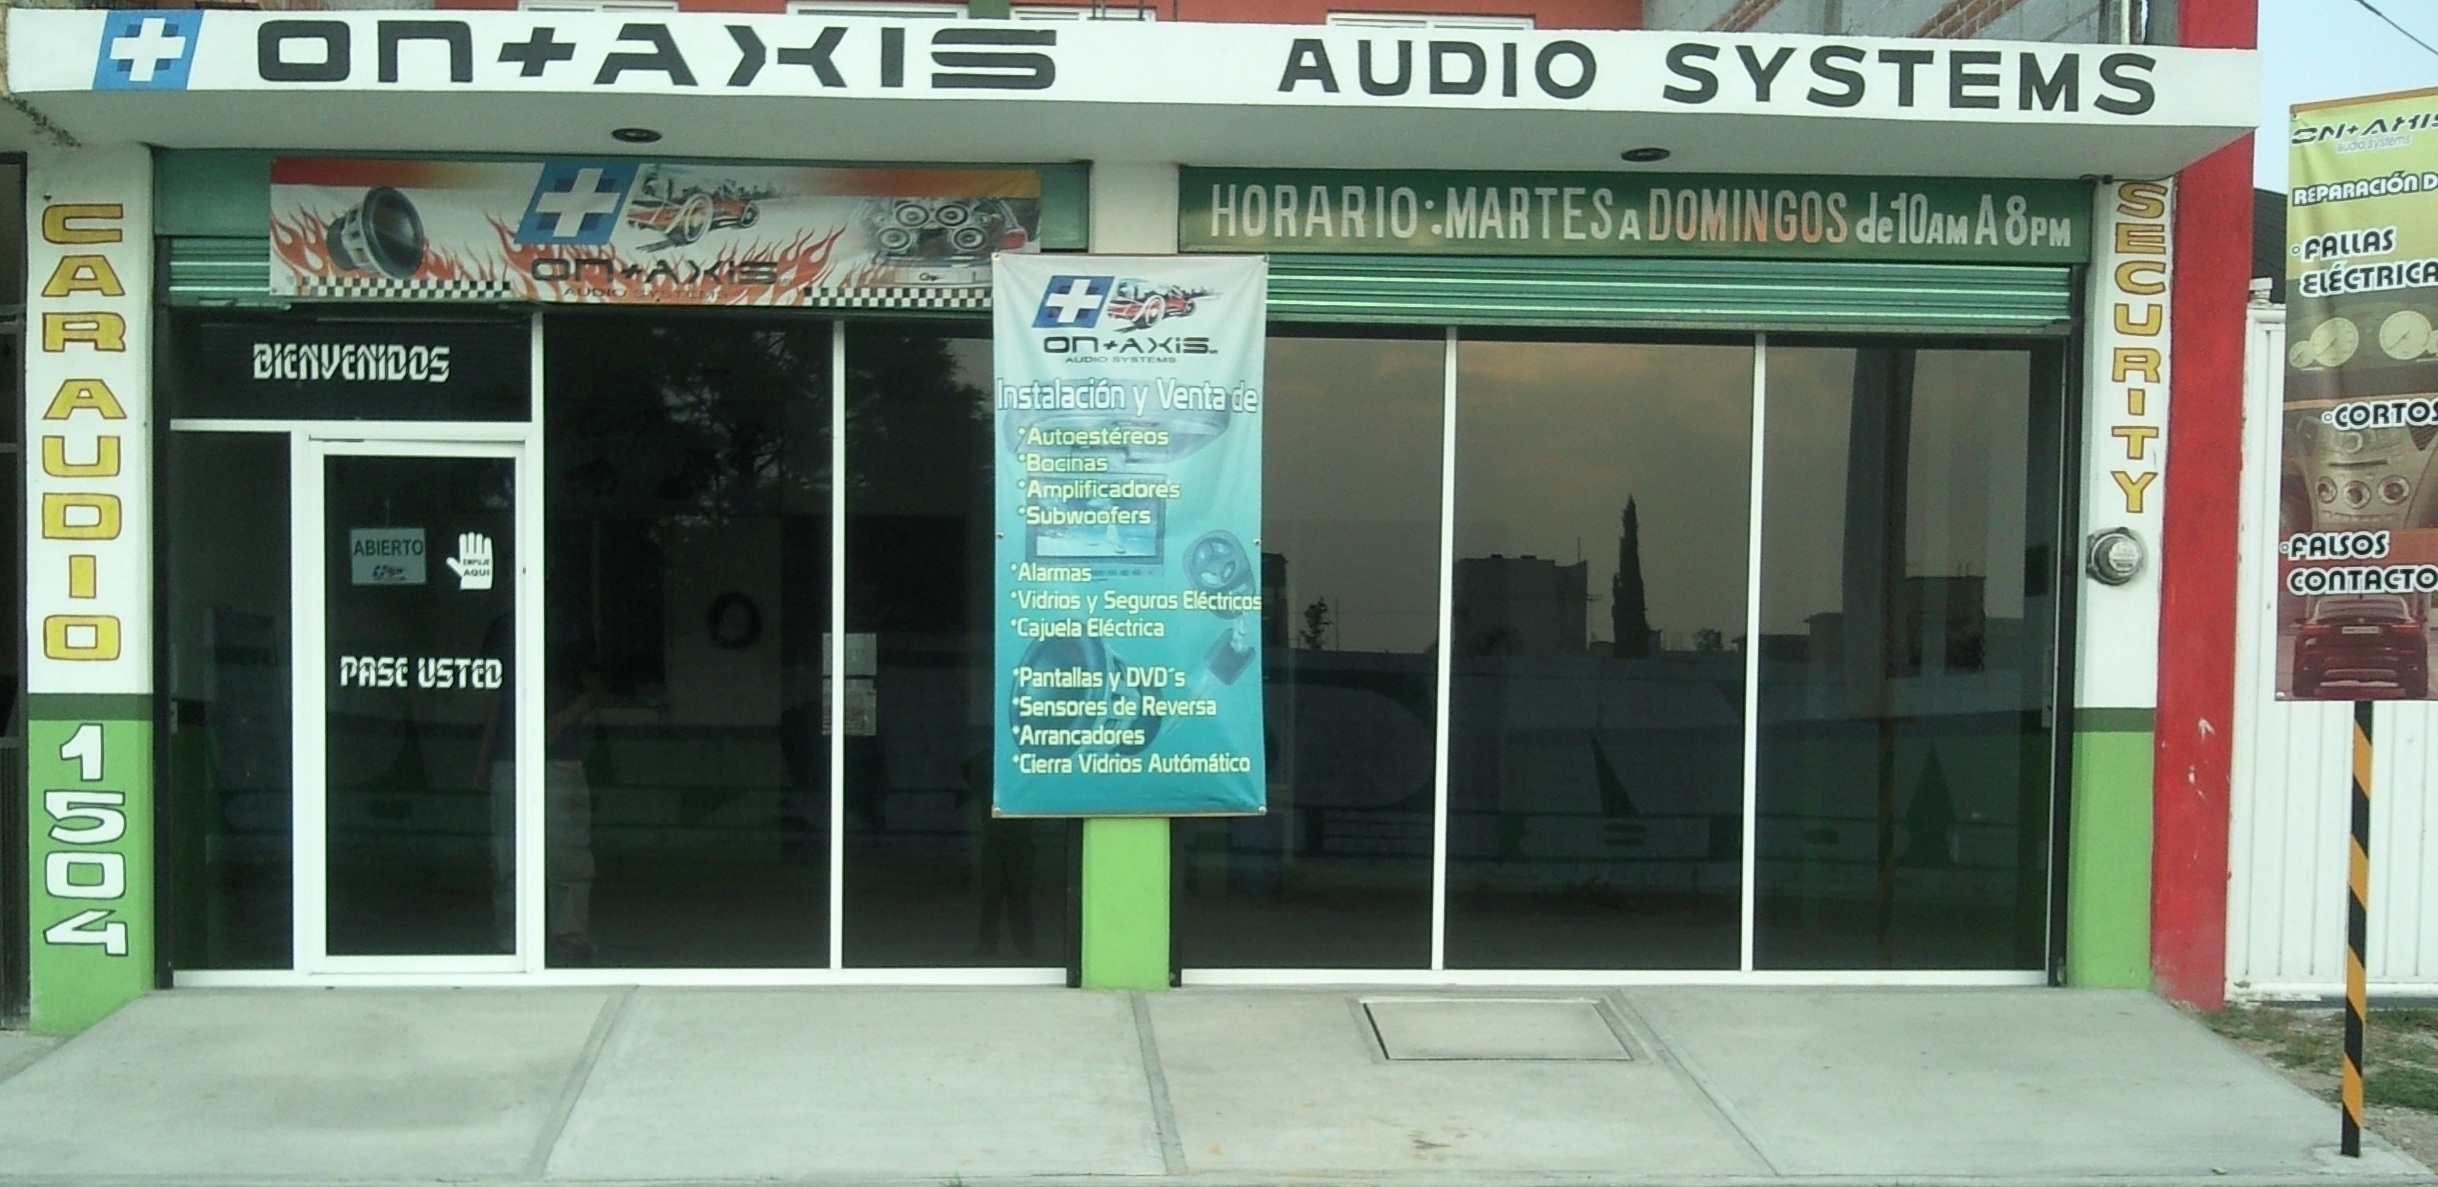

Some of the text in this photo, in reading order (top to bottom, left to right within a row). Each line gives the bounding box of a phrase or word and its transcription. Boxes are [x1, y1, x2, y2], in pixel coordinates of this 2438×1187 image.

[1277, 38, 2157, 116] AUDIO SYSTEMS
[2293, 171, 2418, 206] REPARACIÓN
[1445, 187, 1613, 240] MARTES
[1649, 187, 1848, 244] DOMINGOS
[1974, 194, 1999, 247] A
[2304, 227, 2394, 260] FALLAS
[41, 203, 127, 352] CAR
[564, 287, 627, 298] AUDIO
[2111, 181, 2169, 514] SECURITY
[253, 342, 450, 383] BIENVENIDOS
[1065, 356, 1177, 364] AUDIO SYSTEMS
[997, 377, 1259, 417] Instalación y Venta de
[1027, 426, 1169, 446] Autoestéreos
[1026, 454, 1108, 472] Bocinas
[1027, 479, 1180, 503] Amplificadores
[42, 378, 127, 661] AUDIO
[1026, 506, 1151, 525] Subwoofers
[353, 539, 424, 556] ABIERTO
[2290, 533, 2387, 558] FALSOS
[463, 558, 490, 566] EMPUJE
[463, 569, 490, 577] AQUI
[1017, 562, 1092, 582] Alarmas
[2289, 567, 2438, 592] CONTACTO
[1018, 590, 1262, 613] Vidrios y Seguros Eléctricos
[1017, 617, 1165, 641] Cajuela Eléctrica
[340, 656, 503, 689] PASE USTED
[1019, 667, 1103, 687] Pantallas
[1109, 671, 1121, 691] y
[1019, 695, 1217, 716] Sensores de Reversa
[1019, 725, 1145, 745] Arrancadores
[1019, 753, 1251, 774] Cierra Vidrios Autómático
[43, 723, 128, 957] 1504
